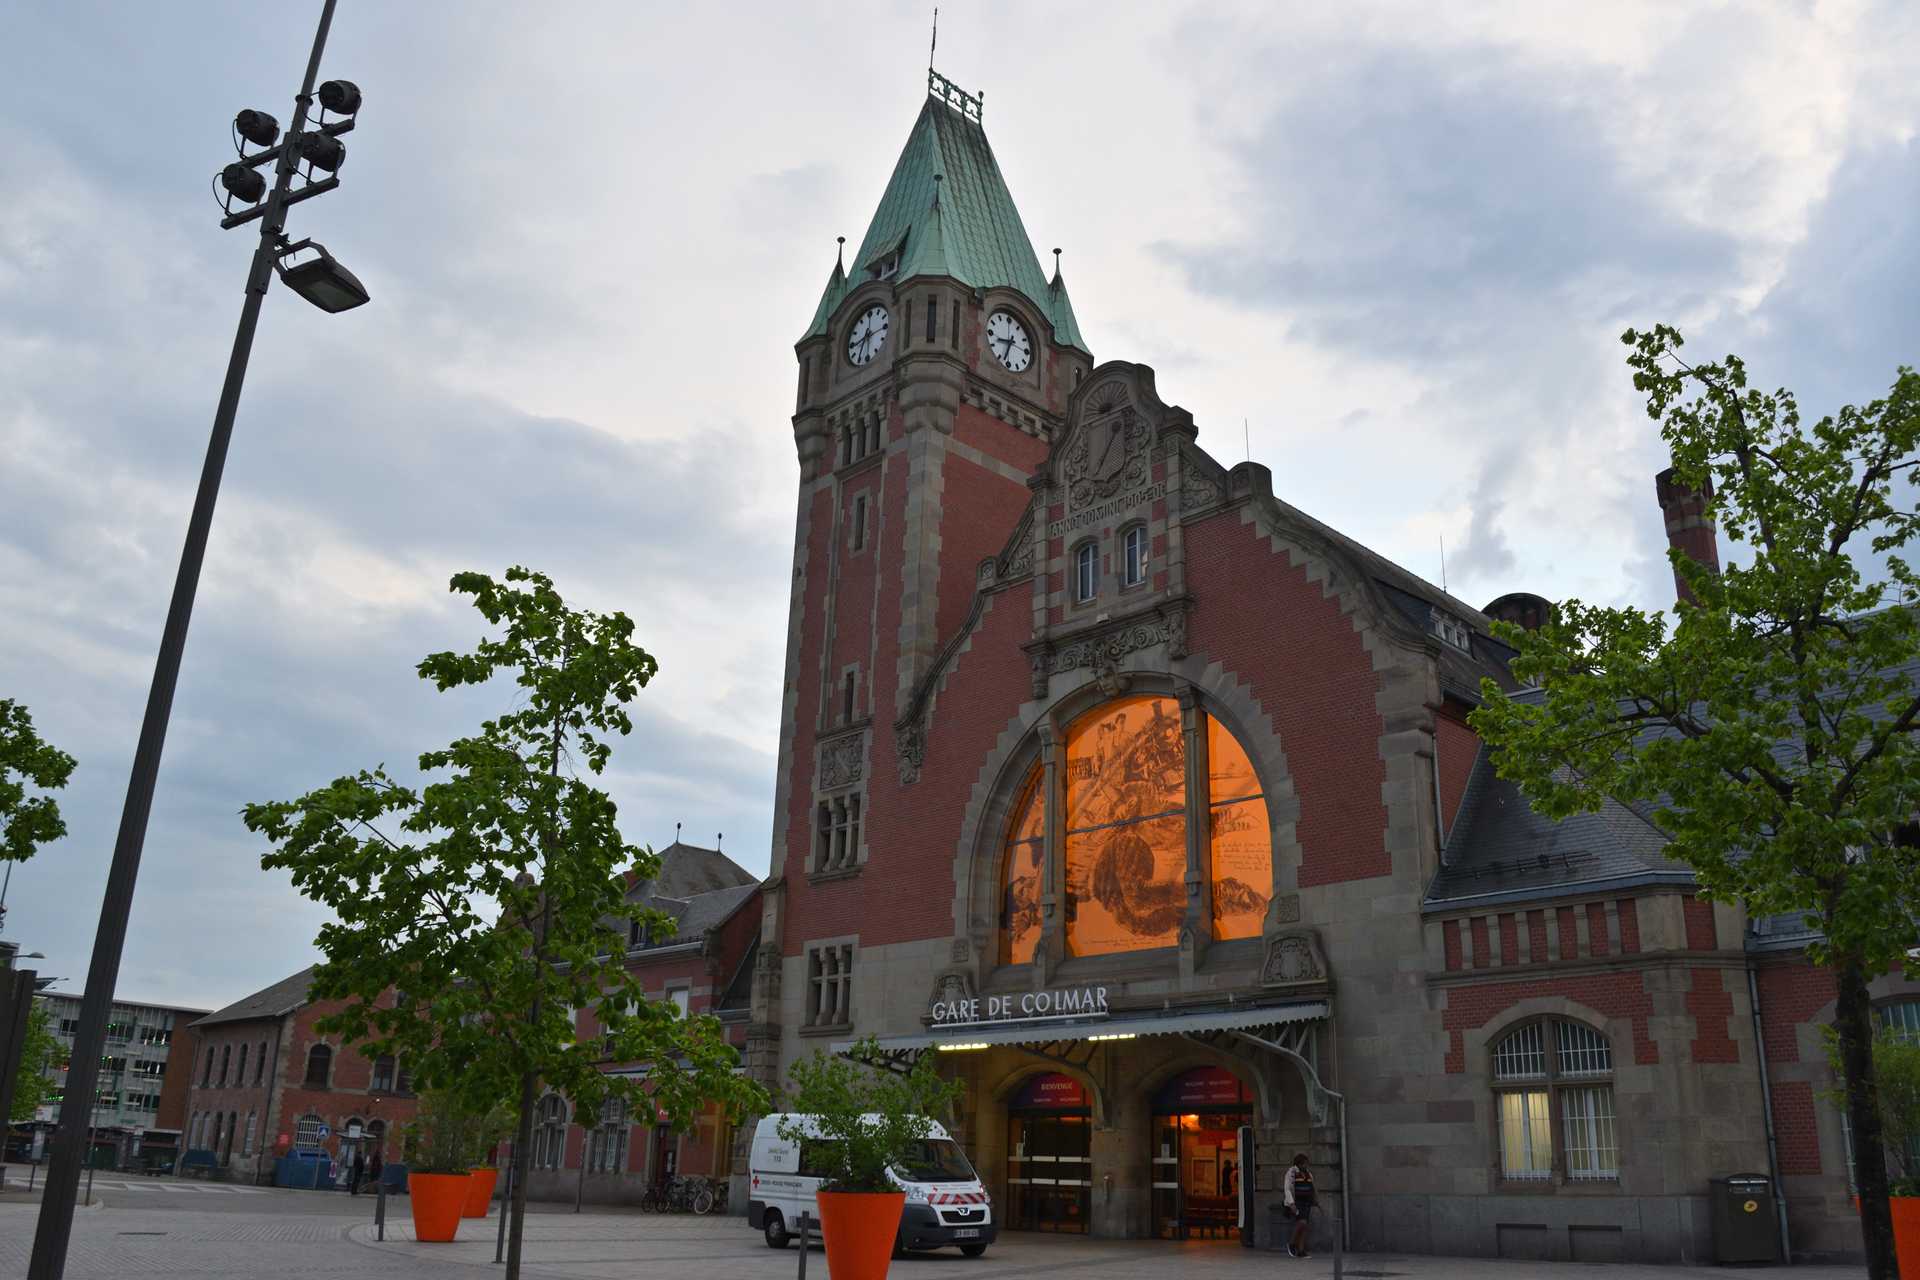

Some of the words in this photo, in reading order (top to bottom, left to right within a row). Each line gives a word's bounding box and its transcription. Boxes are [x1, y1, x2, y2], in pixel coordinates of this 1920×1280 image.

[932, 998, 979, 1021] GARE
[988, 995, 1012, 1016] DE
[1021, 986, 1108, 1014] COLMAR
